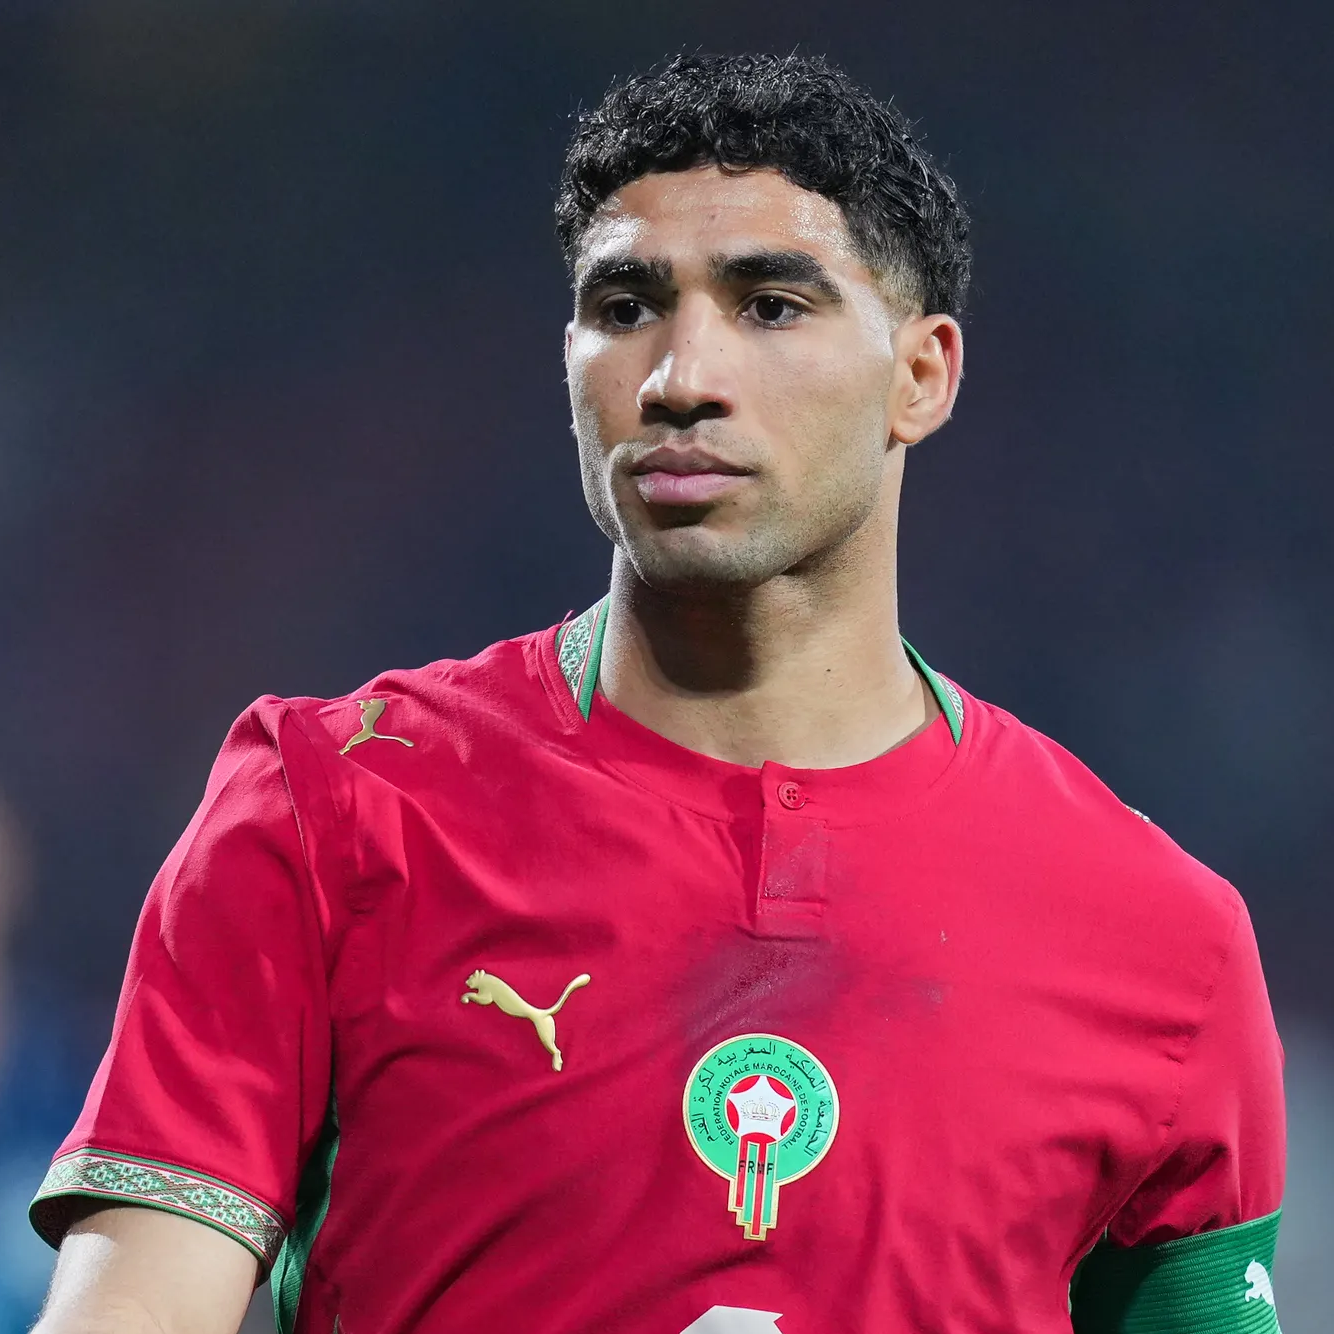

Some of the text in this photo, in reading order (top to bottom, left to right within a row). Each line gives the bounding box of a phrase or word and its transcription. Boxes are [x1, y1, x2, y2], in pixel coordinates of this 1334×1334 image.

[691, 1041, 832, 1157] الجامعة الملكية المغربية لكرة القدم
[713, 1062, 809, 1150] FEDERATION ROYALE MAROCAINE DE FOOTBALL
[738, 1160, 774, 1176] FRMF
